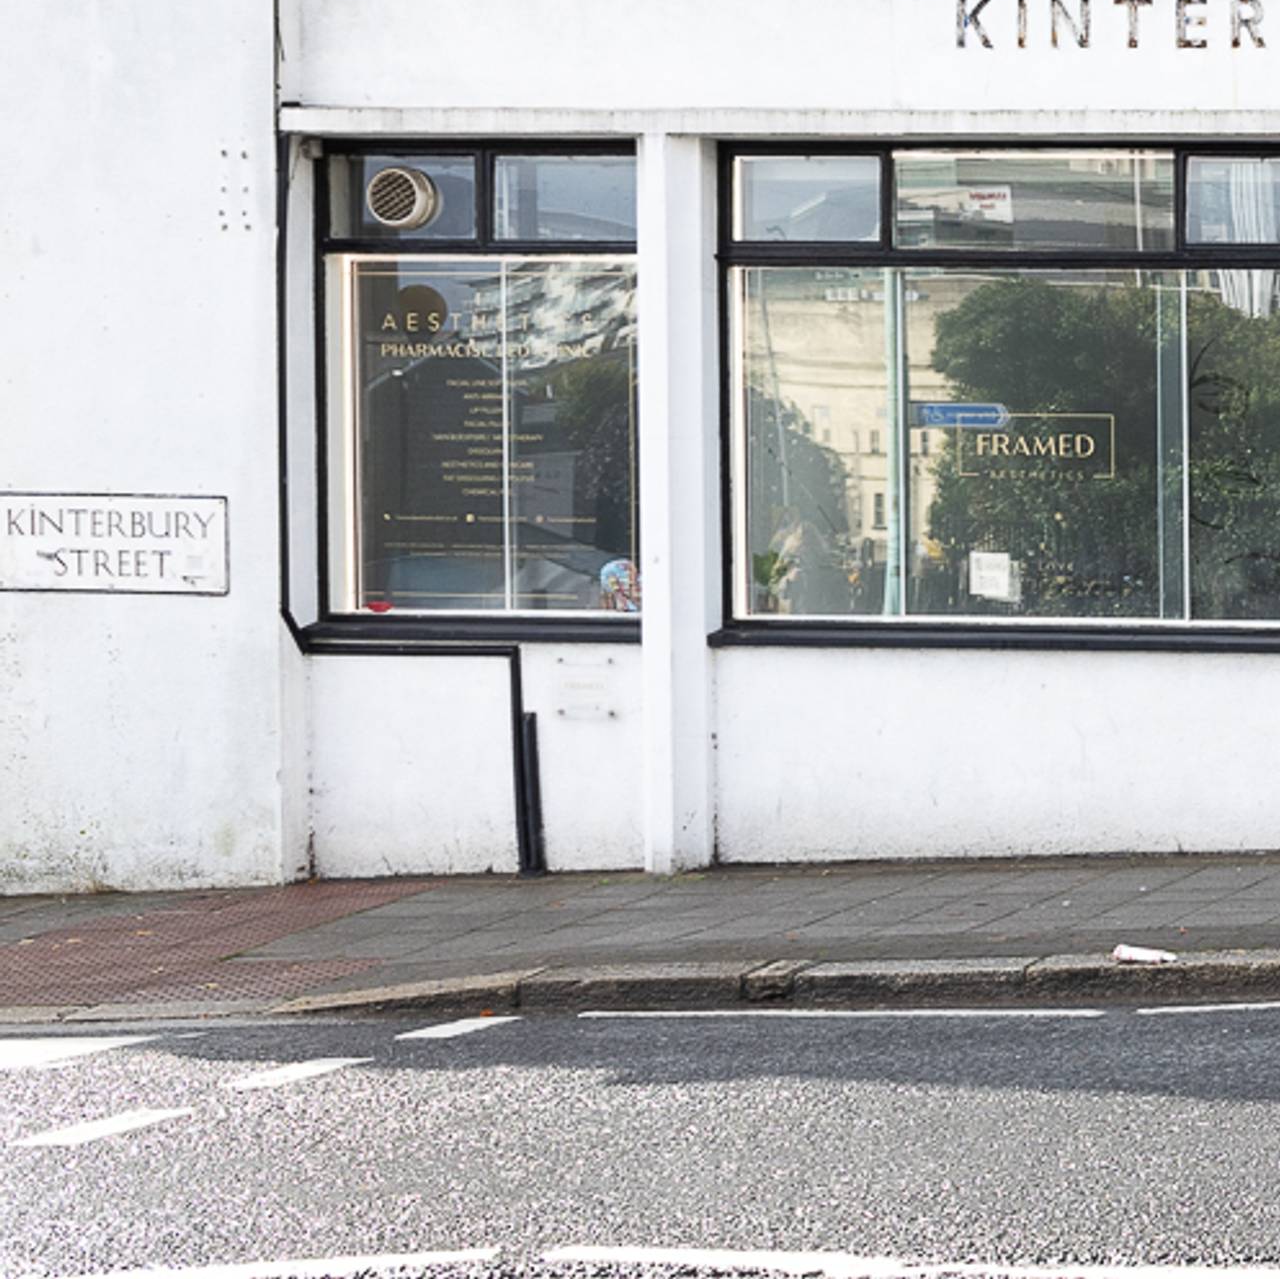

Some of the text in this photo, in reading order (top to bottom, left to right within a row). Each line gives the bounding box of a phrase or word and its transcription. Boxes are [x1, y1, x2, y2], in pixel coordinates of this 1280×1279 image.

[381, 312, 592, 332] AESTHETS
[975, 433, 1096, 458] FRAMED
[6, 506, 216, 539] KINTERBURY
[52, 547, 173, 579] STREET
